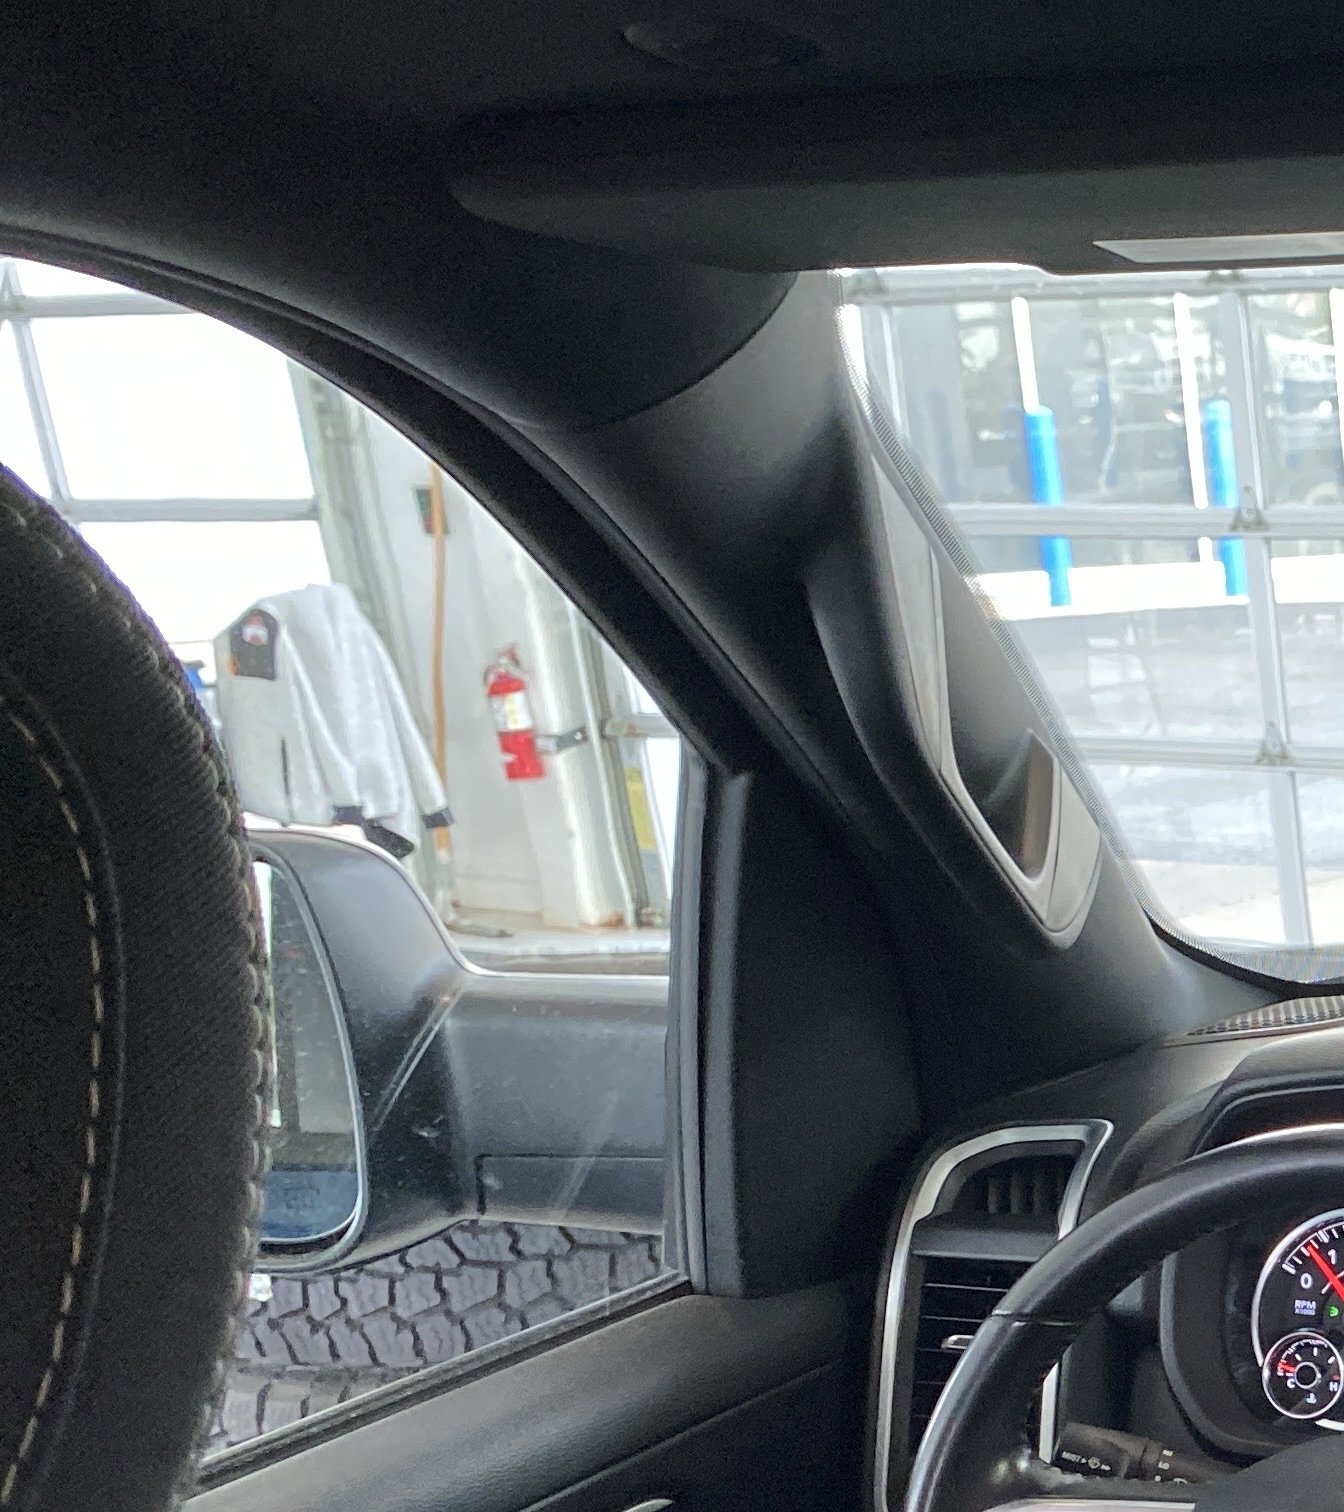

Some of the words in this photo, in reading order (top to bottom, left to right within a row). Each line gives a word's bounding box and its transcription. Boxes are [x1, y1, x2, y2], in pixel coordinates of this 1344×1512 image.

[1328, 1249, 1336, 1264] 1
[1301, 1273, 1312, 1288] 0
[1295, 1300, 1316, 1309] RPM
[1287, 1379, 1296, 1388] C
[1329, 1382, 1338, 1392] H
